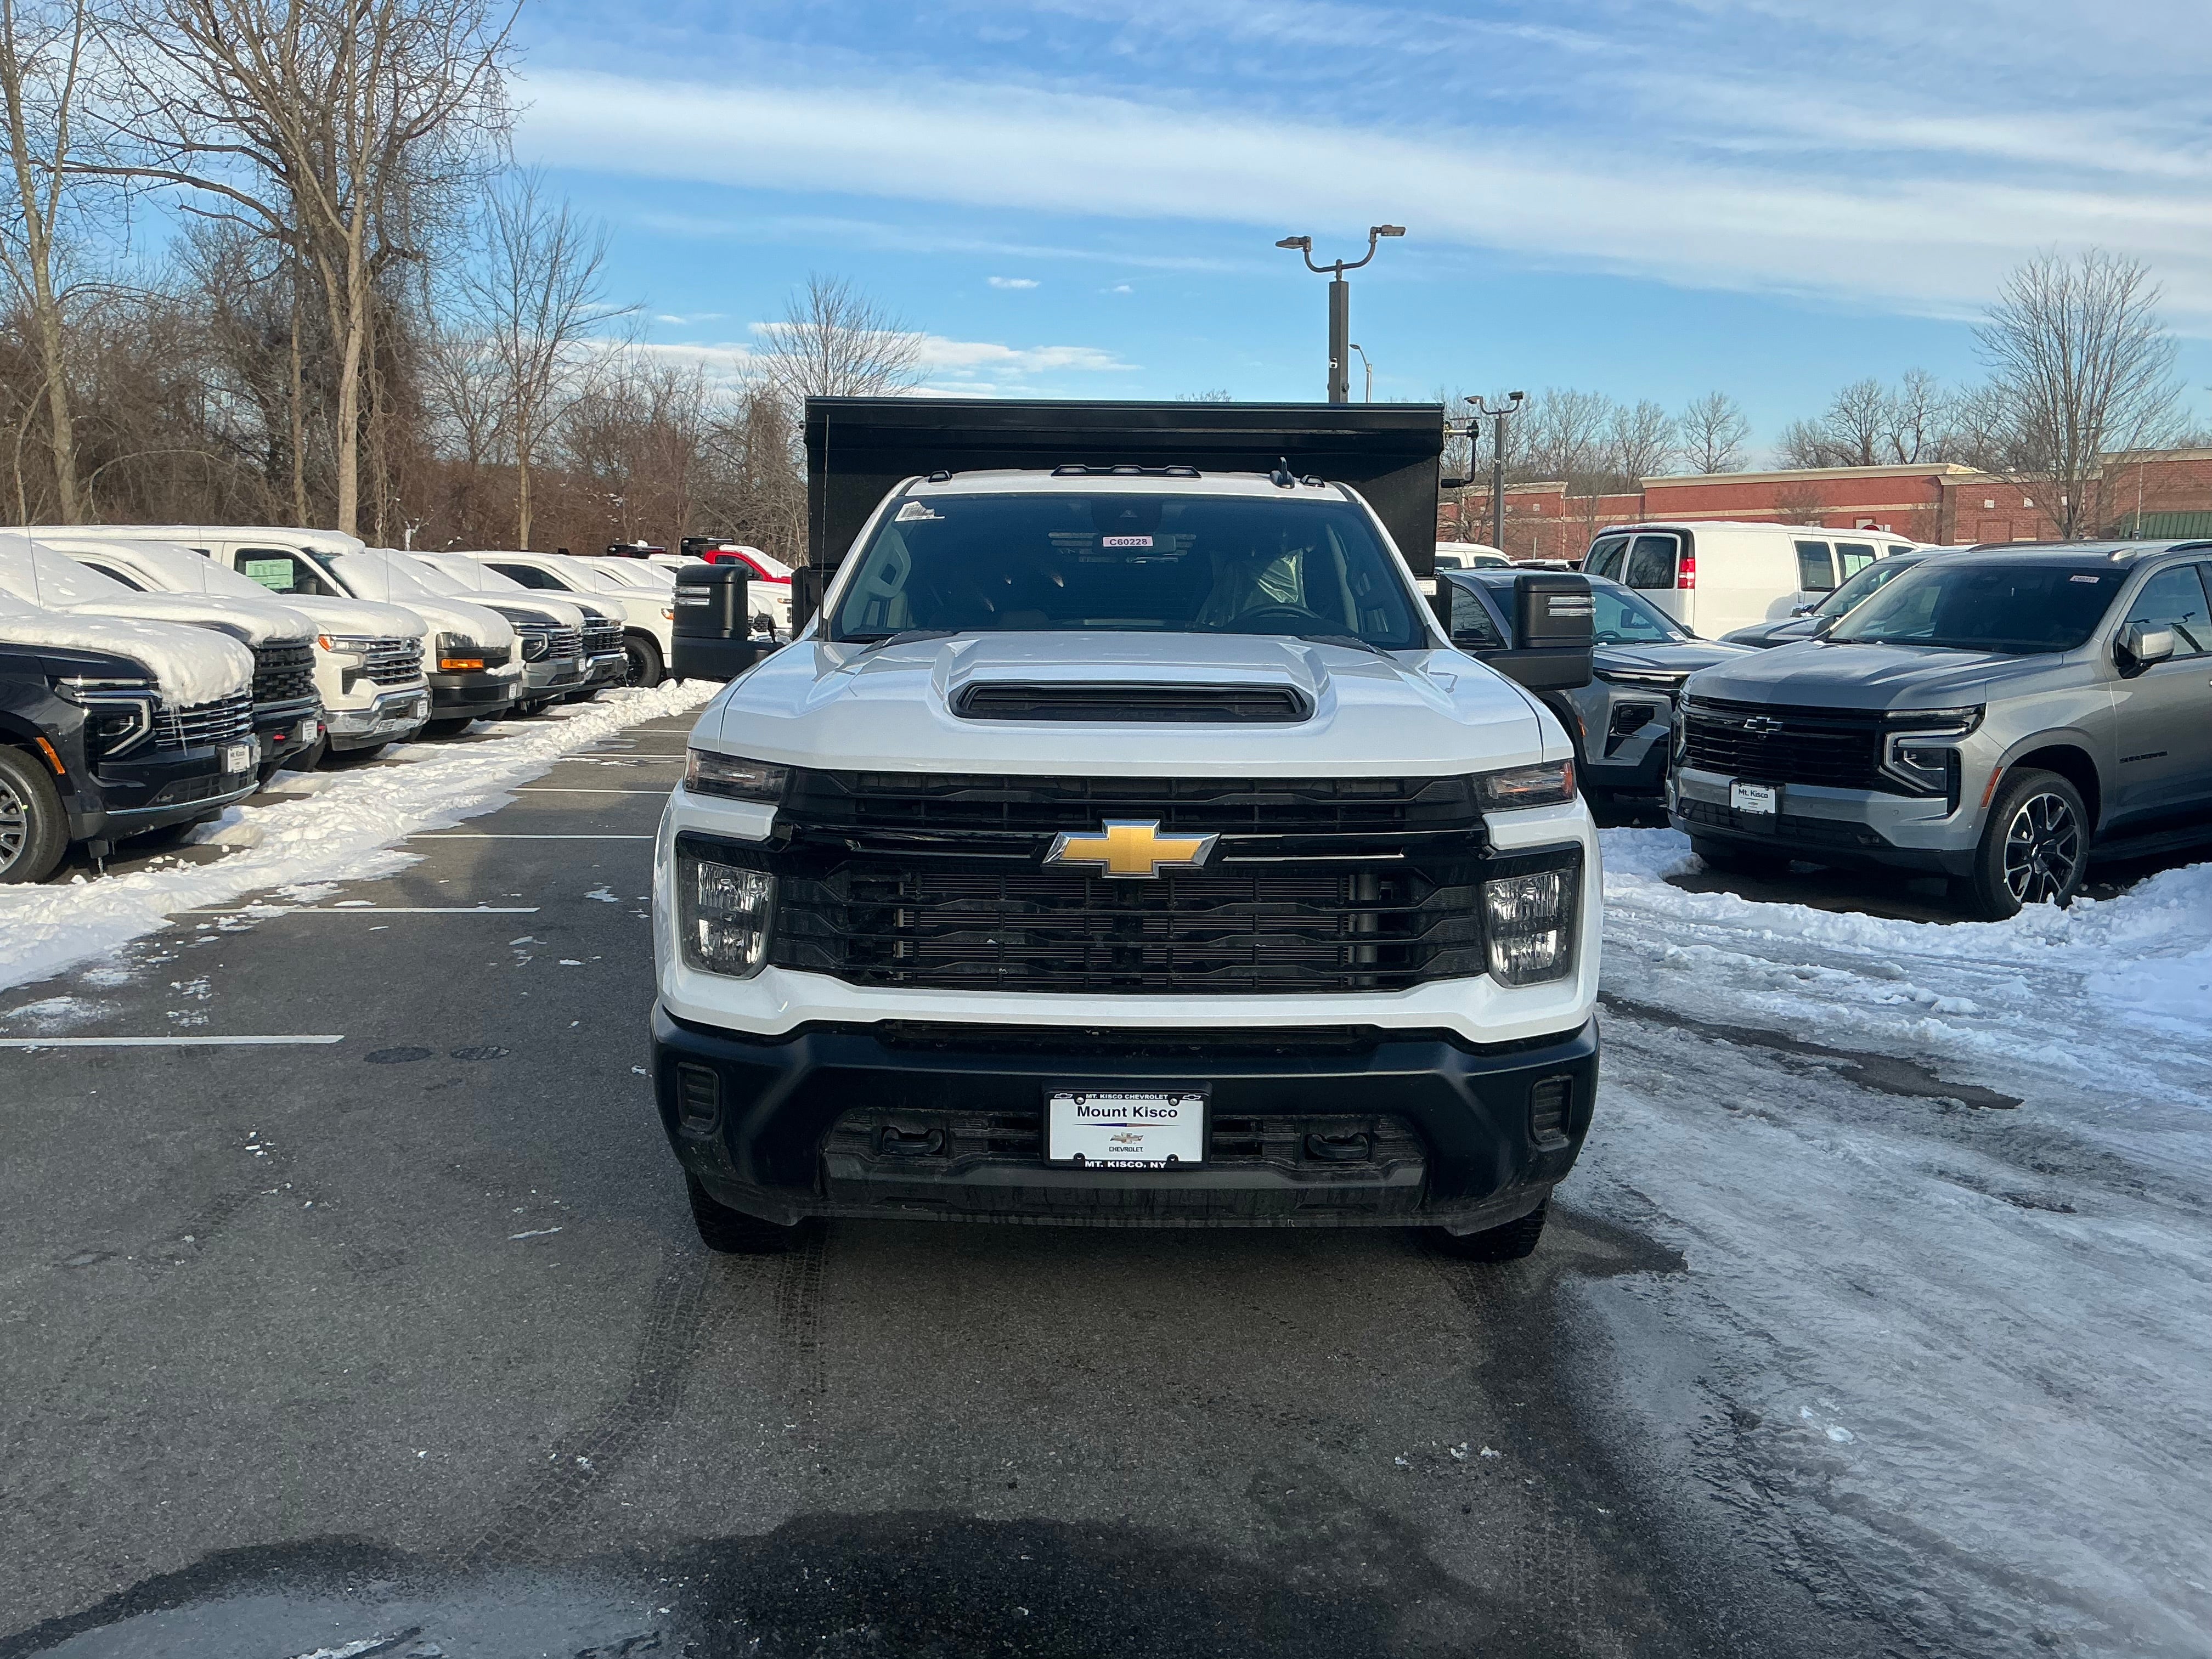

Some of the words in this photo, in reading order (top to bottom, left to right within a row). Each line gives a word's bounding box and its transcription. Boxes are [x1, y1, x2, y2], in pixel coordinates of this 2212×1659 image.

[1751, 790, 1768, 798] Kisco
[1077, 1106, 1127, 1117] Mount
[1133, 1106, 1178, 1118] Kisco
